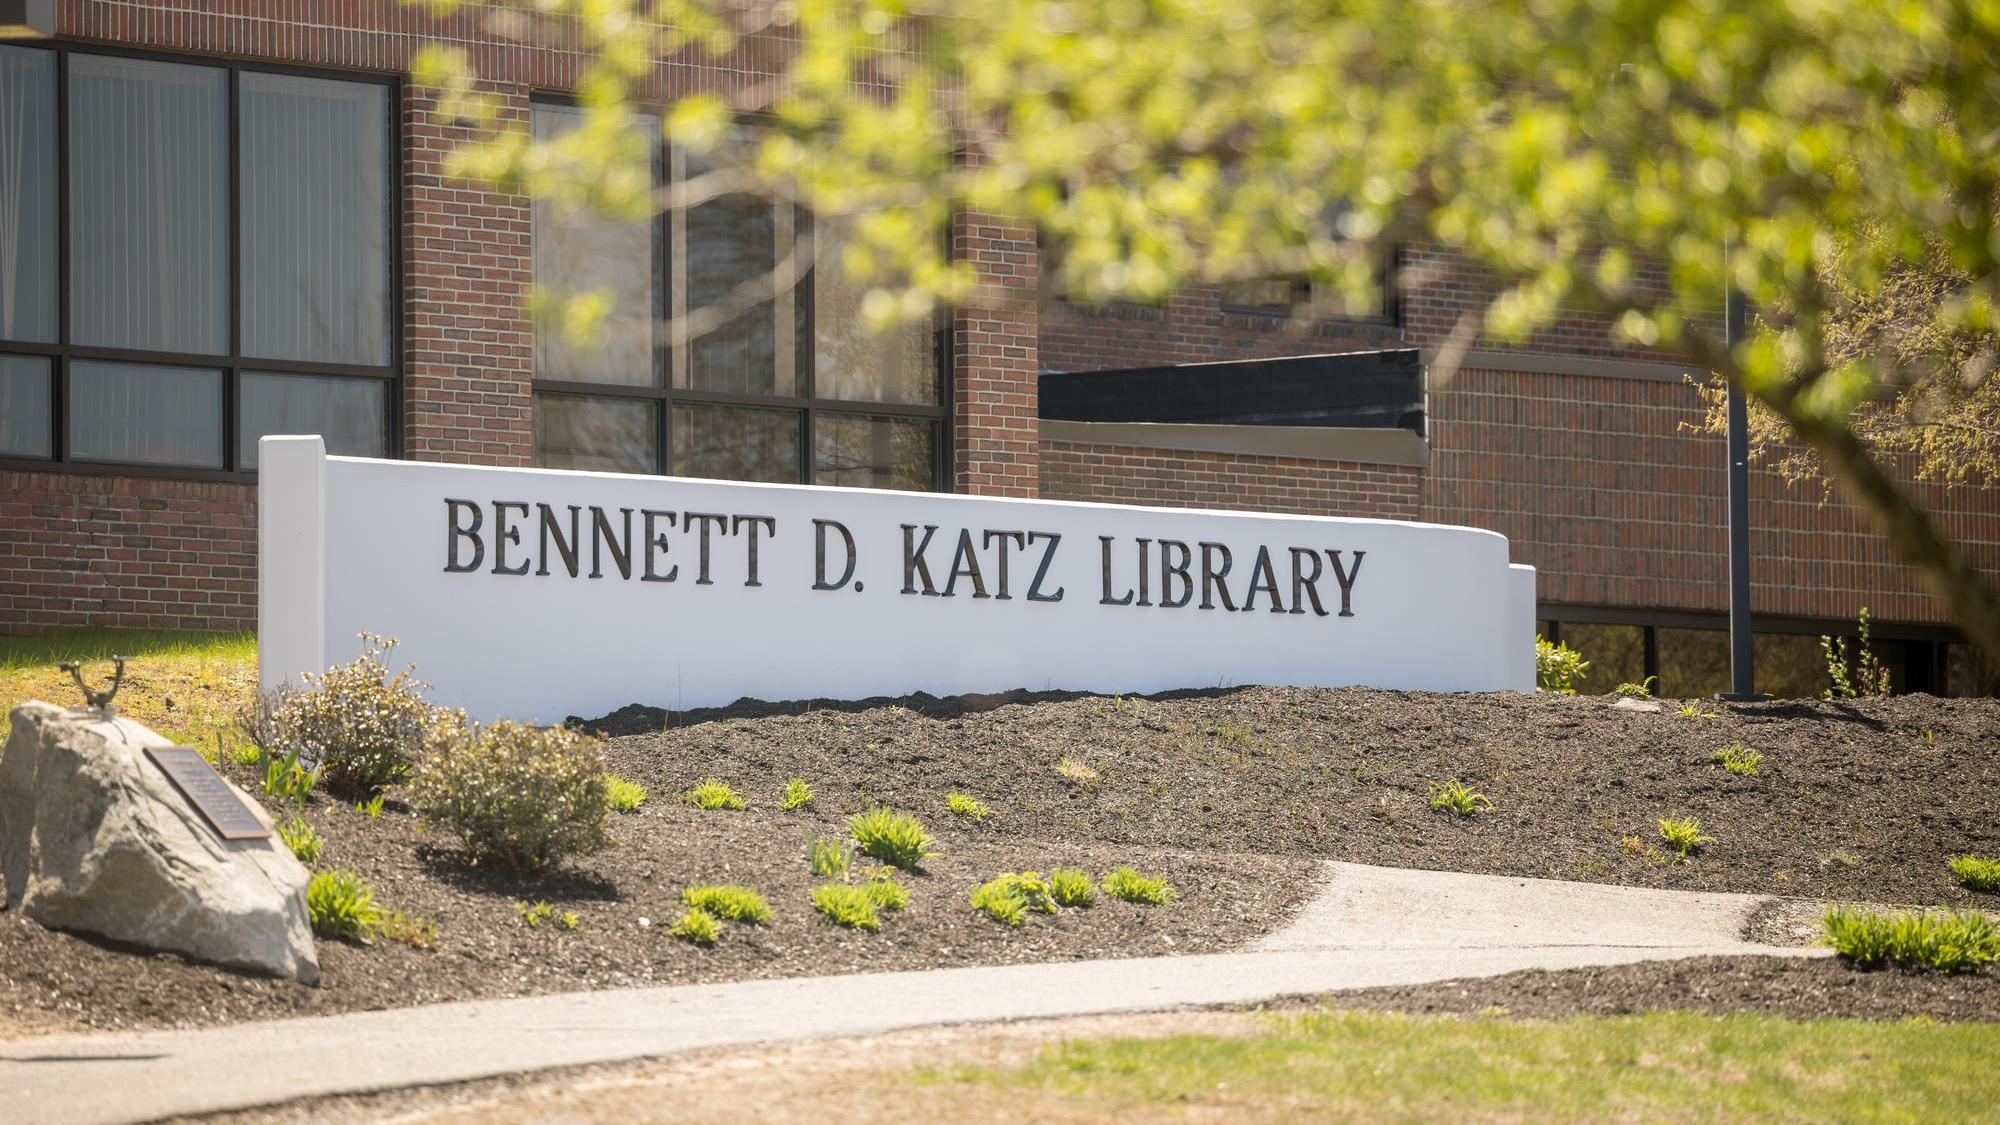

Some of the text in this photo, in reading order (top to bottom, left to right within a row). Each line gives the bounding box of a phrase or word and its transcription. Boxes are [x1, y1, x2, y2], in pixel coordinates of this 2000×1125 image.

[443, 497, 1368, 618] BENNETT D. KATZ LIBRARY
